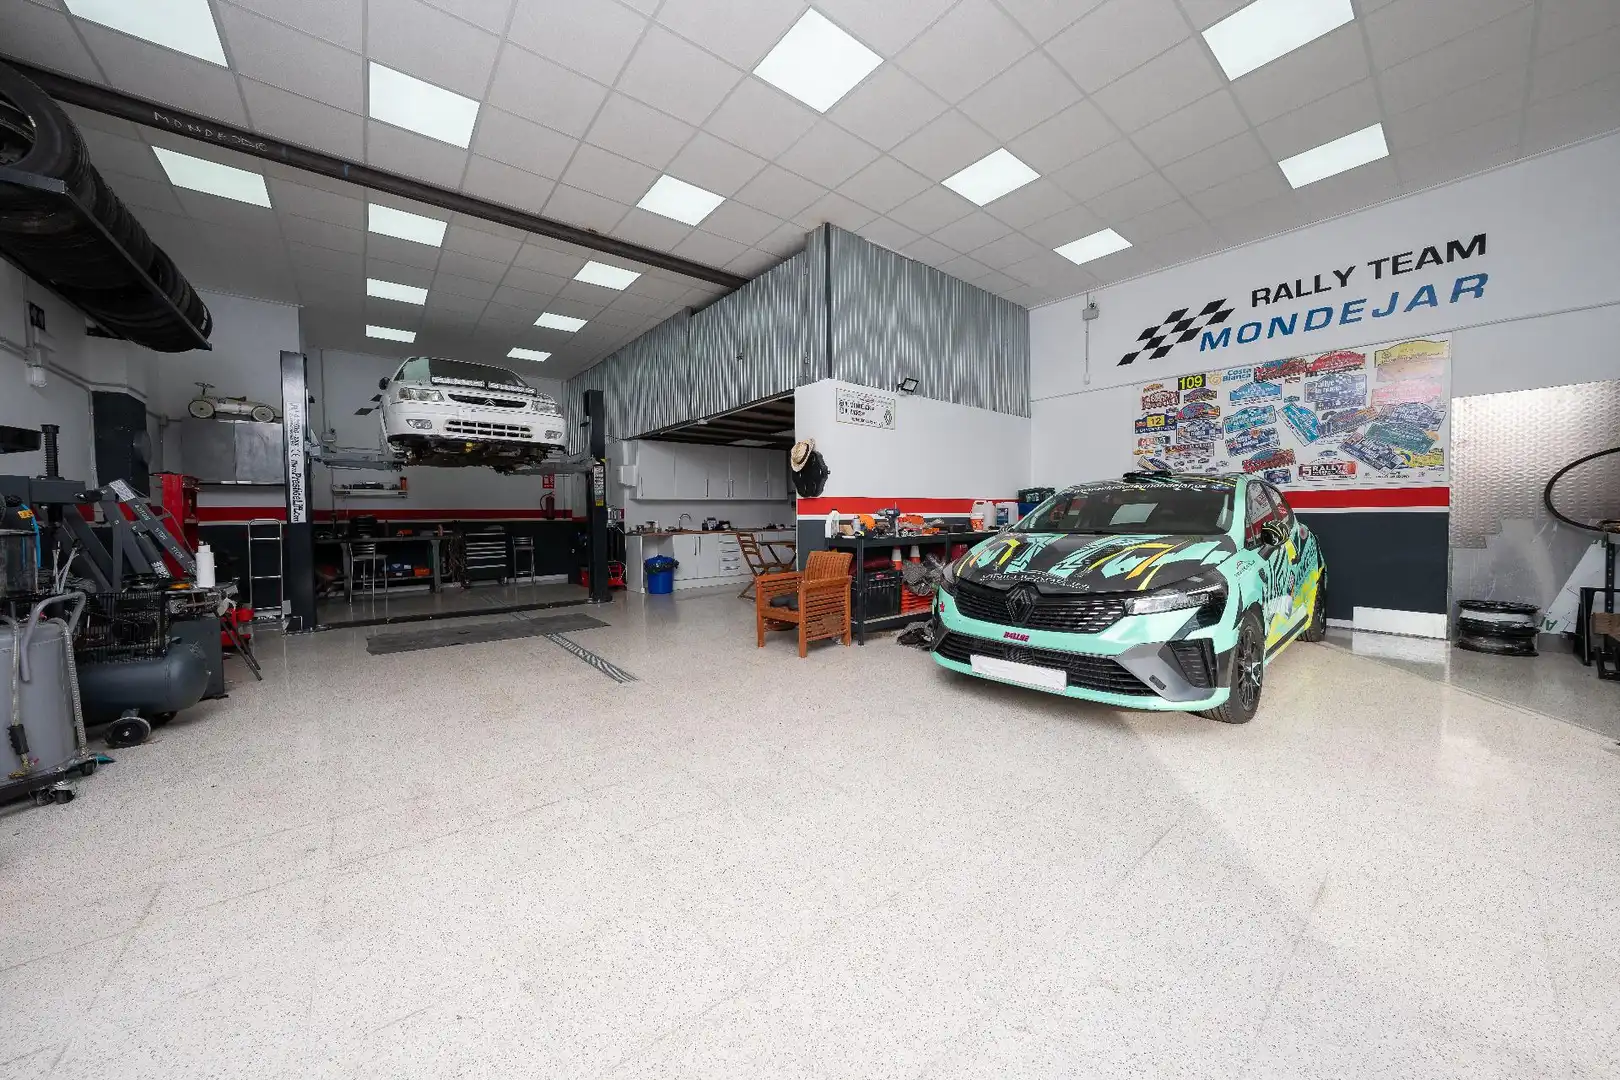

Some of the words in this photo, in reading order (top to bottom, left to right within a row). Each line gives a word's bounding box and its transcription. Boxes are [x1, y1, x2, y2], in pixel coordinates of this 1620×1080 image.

[1251, 265, 1356, 308] RALLY
[1367, 232, 1487, 280] TEAM
[1200, 272, 1489, 352] MONDEJAR
[1222, 373, 1251, 382] Blanca
[1227, 368, 1252, 376] Costa
[1180, 375, 1203, 389] 109
[1150, 417, 1162, 426] 12
[1302, 466, 1312, 477] 5
